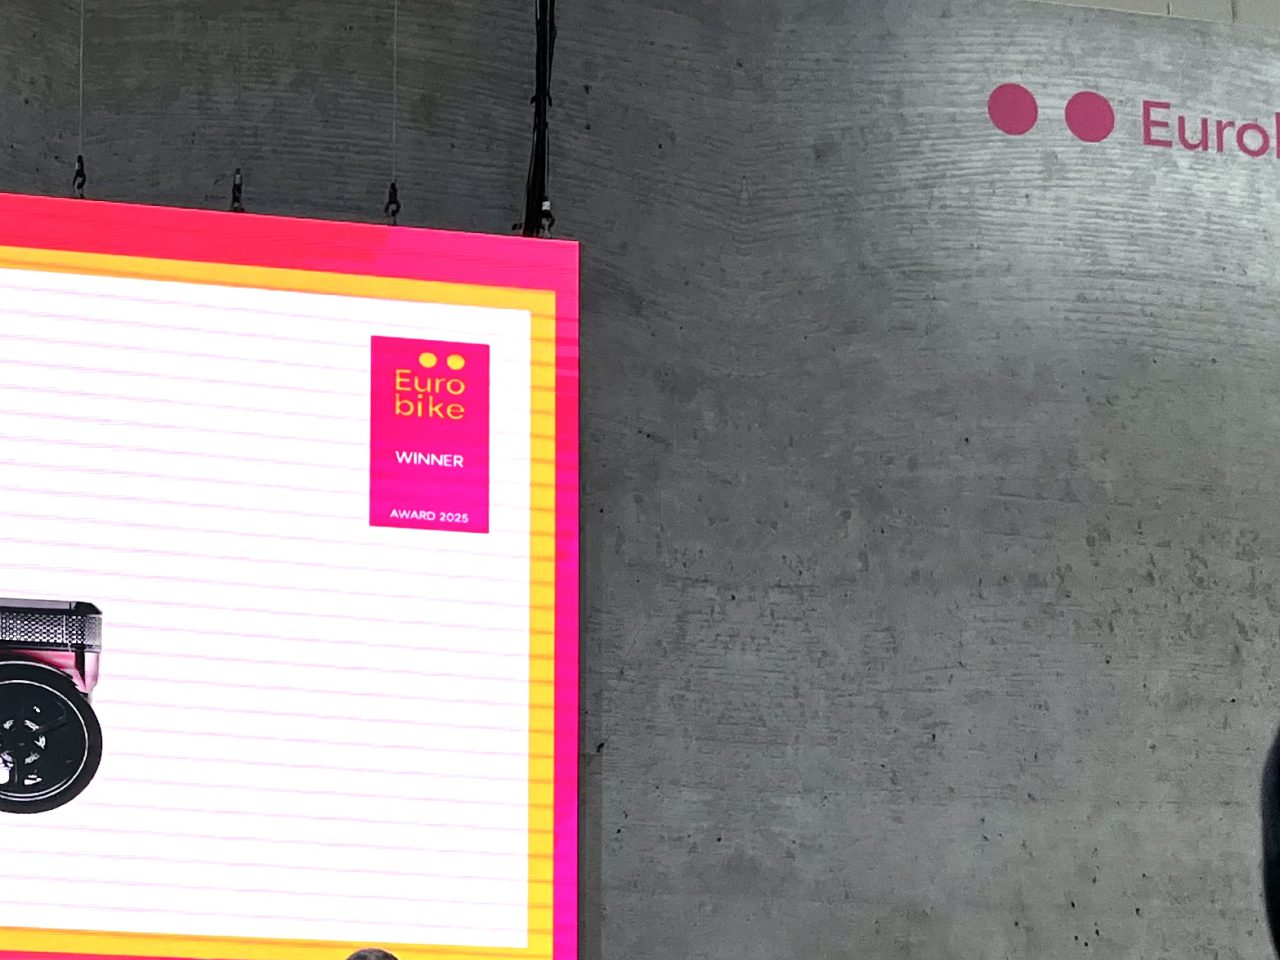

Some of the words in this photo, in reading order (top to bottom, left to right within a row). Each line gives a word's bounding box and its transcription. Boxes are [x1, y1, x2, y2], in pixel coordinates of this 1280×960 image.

[1142, 99, 1280, 159] Euro
[395, 368, 465, 396] Euro
[395, 393, 465, 420] bike
[395, 450, 464, 468] WINNER
[390, 508, 436, 521] AWARD
[439, 511, 469, 524] 2025
